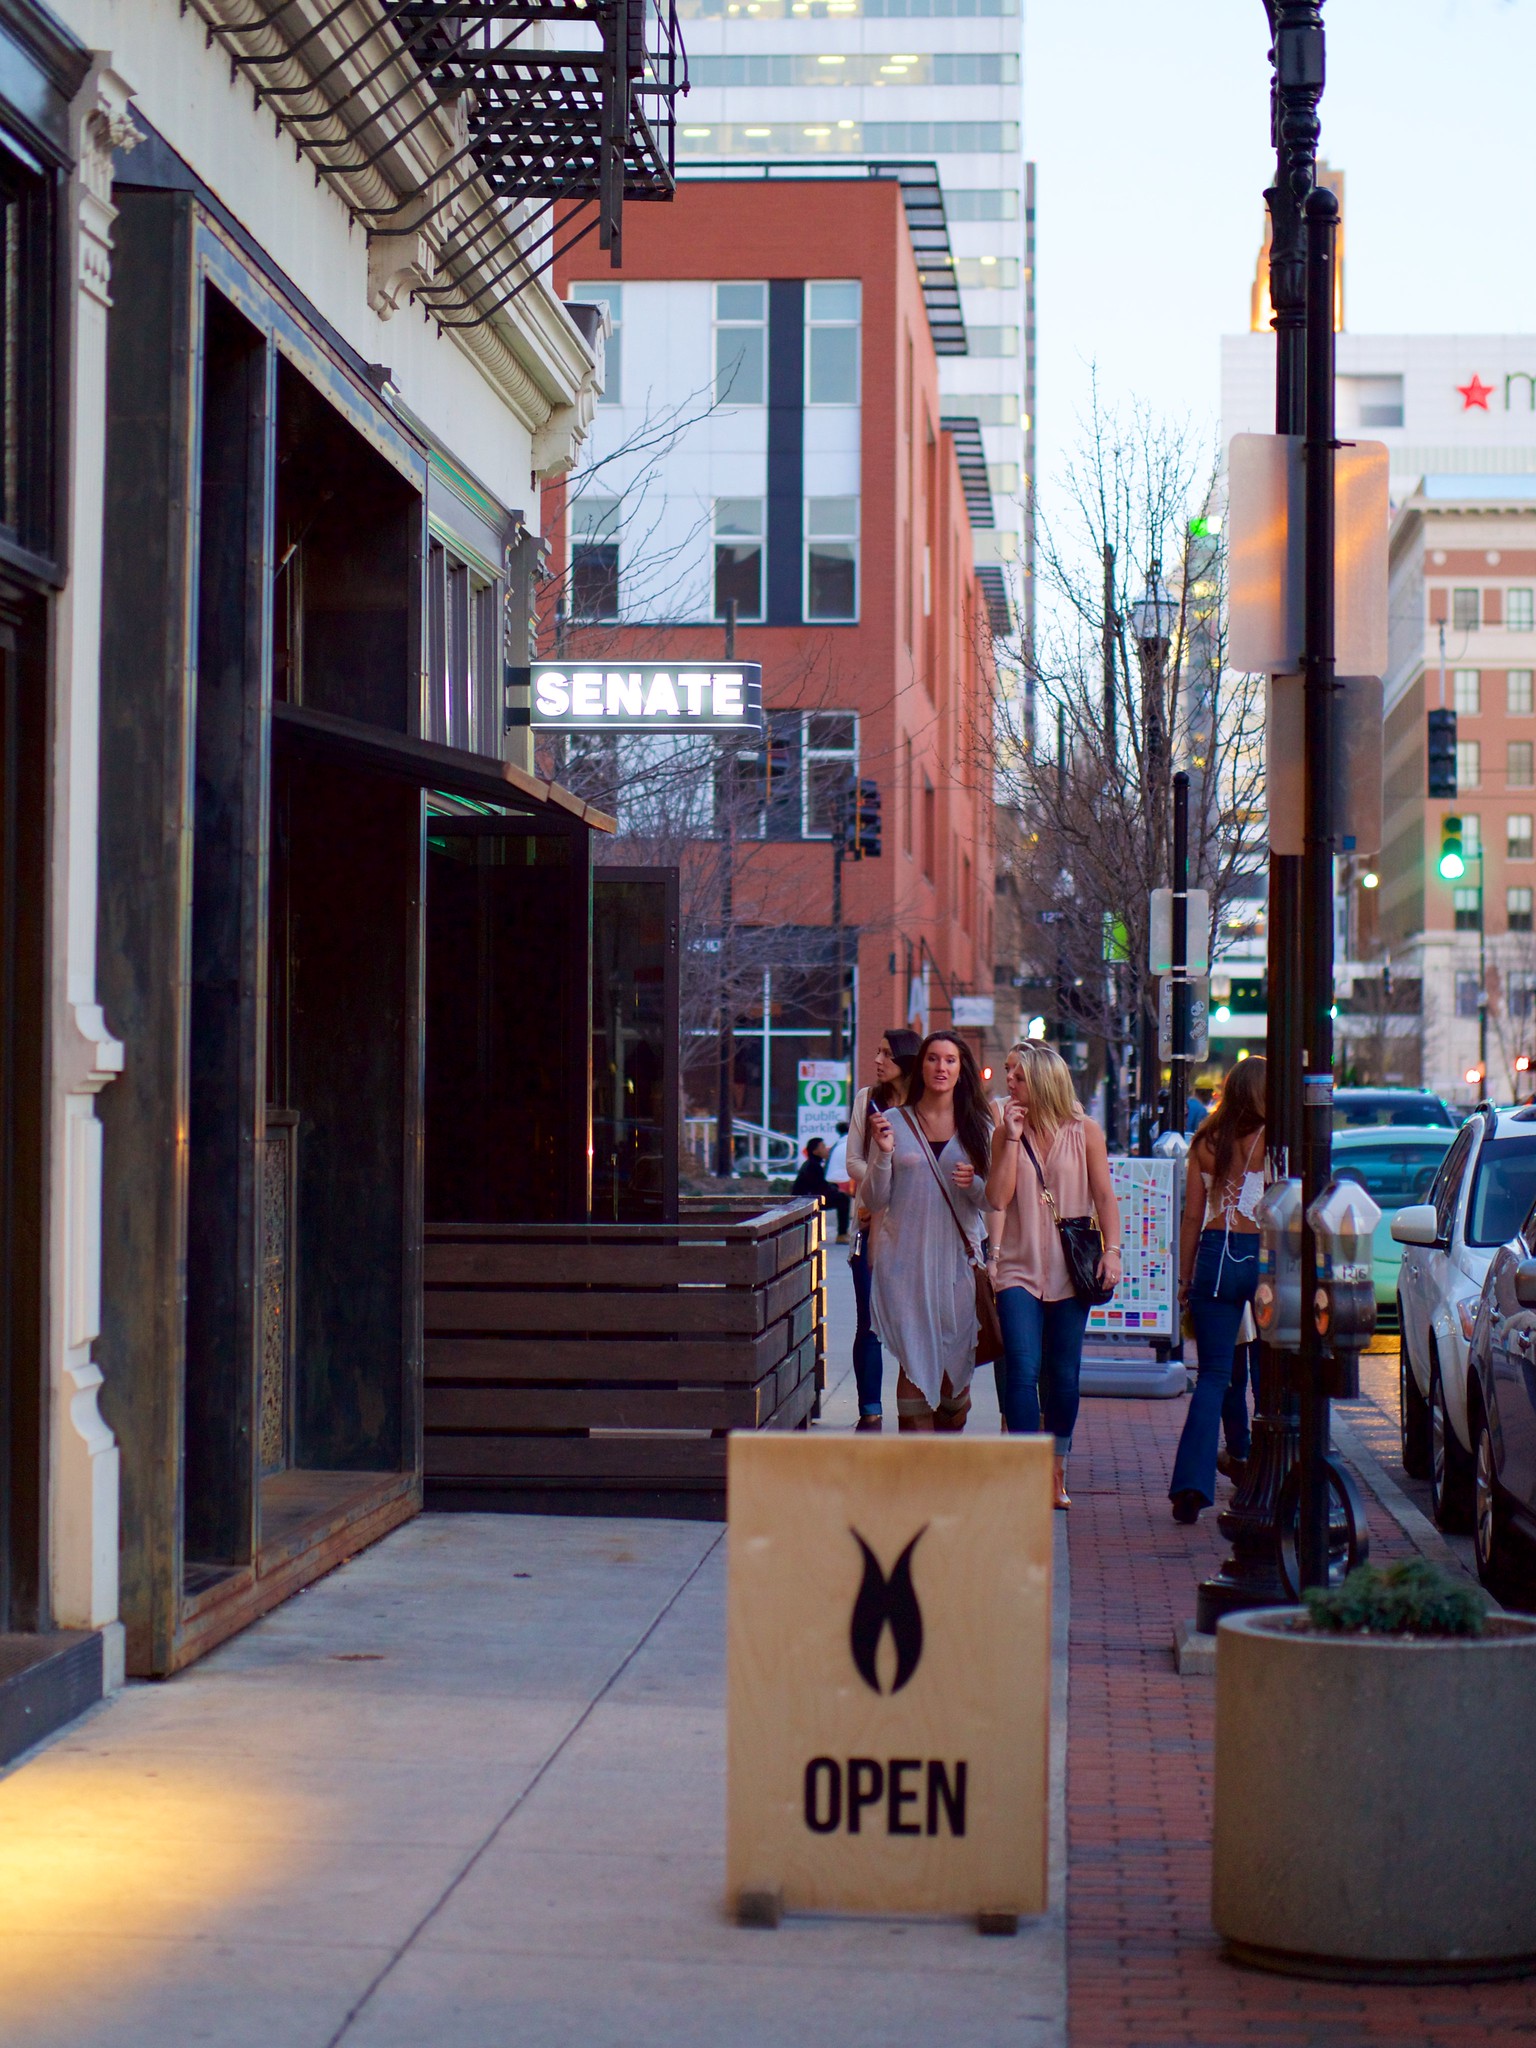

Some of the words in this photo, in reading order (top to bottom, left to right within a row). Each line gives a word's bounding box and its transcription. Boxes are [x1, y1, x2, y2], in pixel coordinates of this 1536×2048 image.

[535, 671, 745, 717] SENATE
[816, 1083, 832, 1104] P
[804, 1110, 842, 1123] public
[800, 1122, 837, 1134] parkin
[804, 1757, 968, 1837] OPEN
